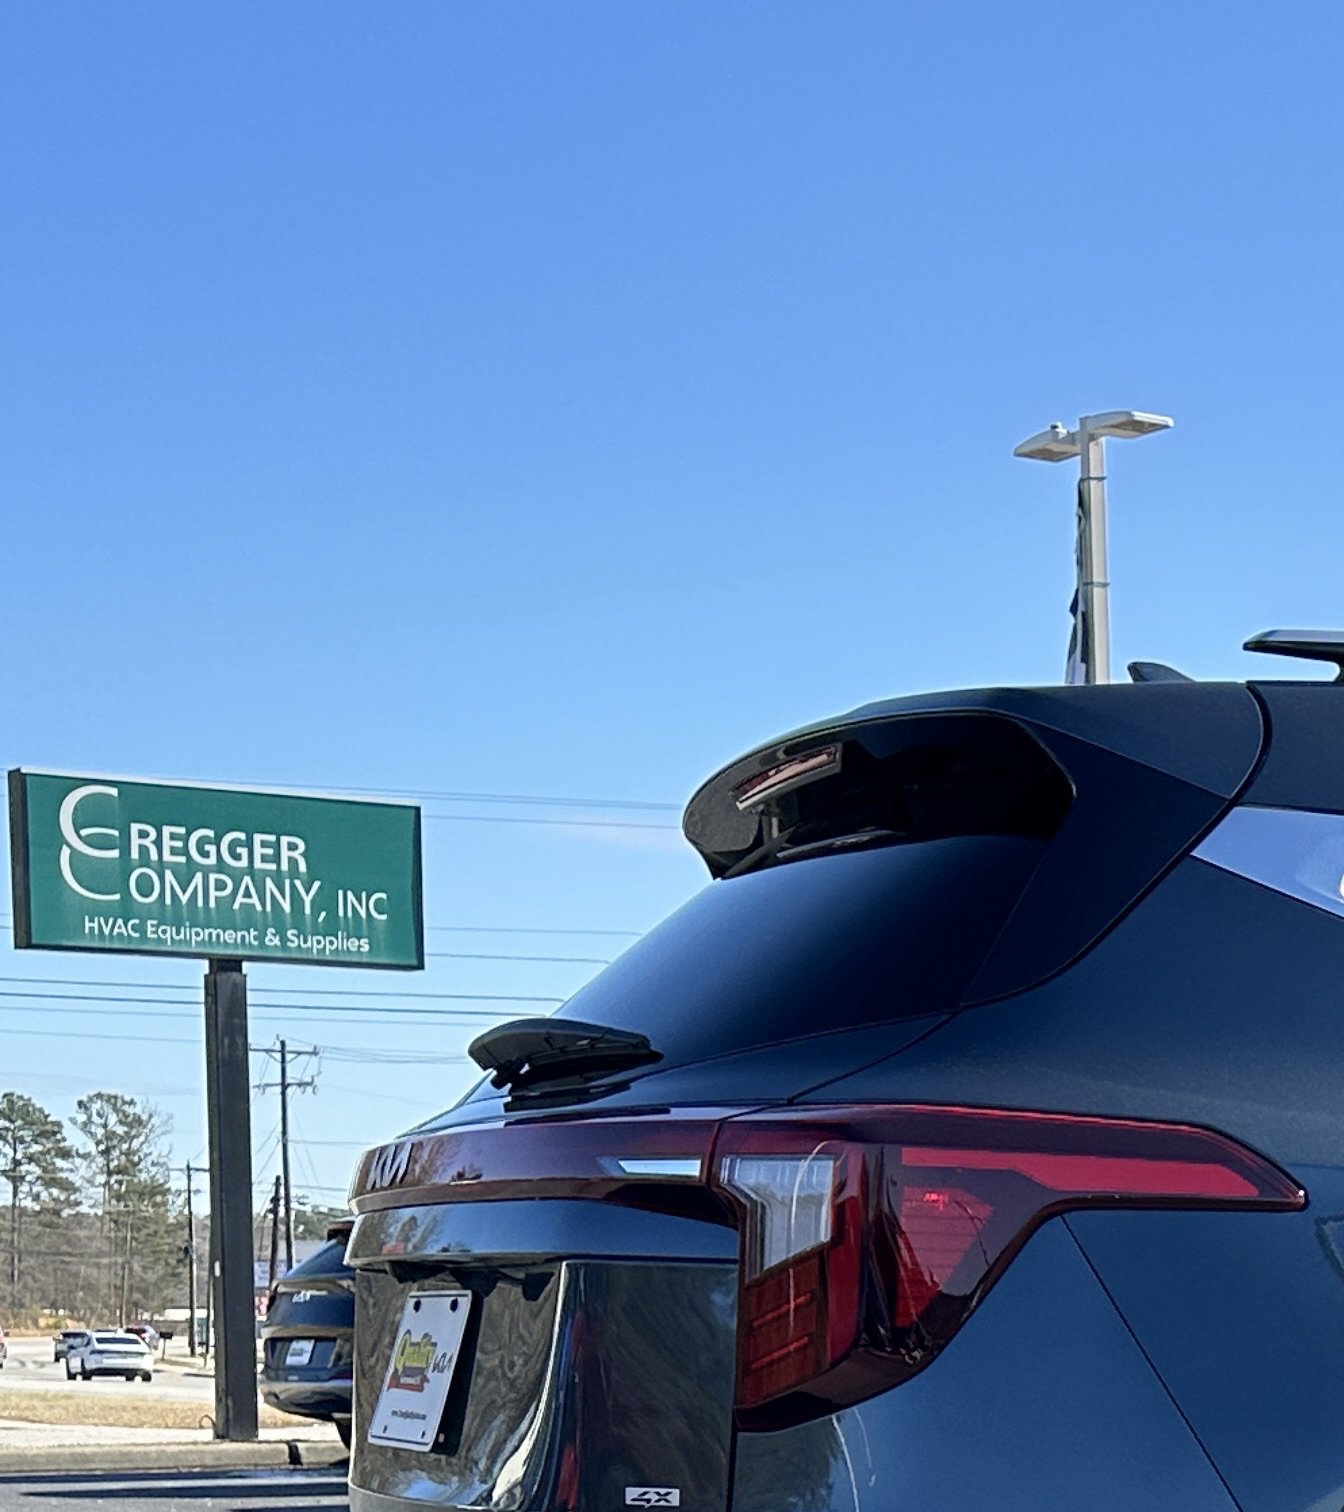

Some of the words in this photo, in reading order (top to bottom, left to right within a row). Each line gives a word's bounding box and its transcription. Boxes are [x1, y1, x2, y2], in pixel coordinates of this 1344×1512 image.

[337, 889, 388, 921] INC
[84, 915, 140, 938] HVAC
[146, 920, 258, 948] Equipment
[264, 927, 280, 945] &
[286, 930, 370, 955] Supplies
